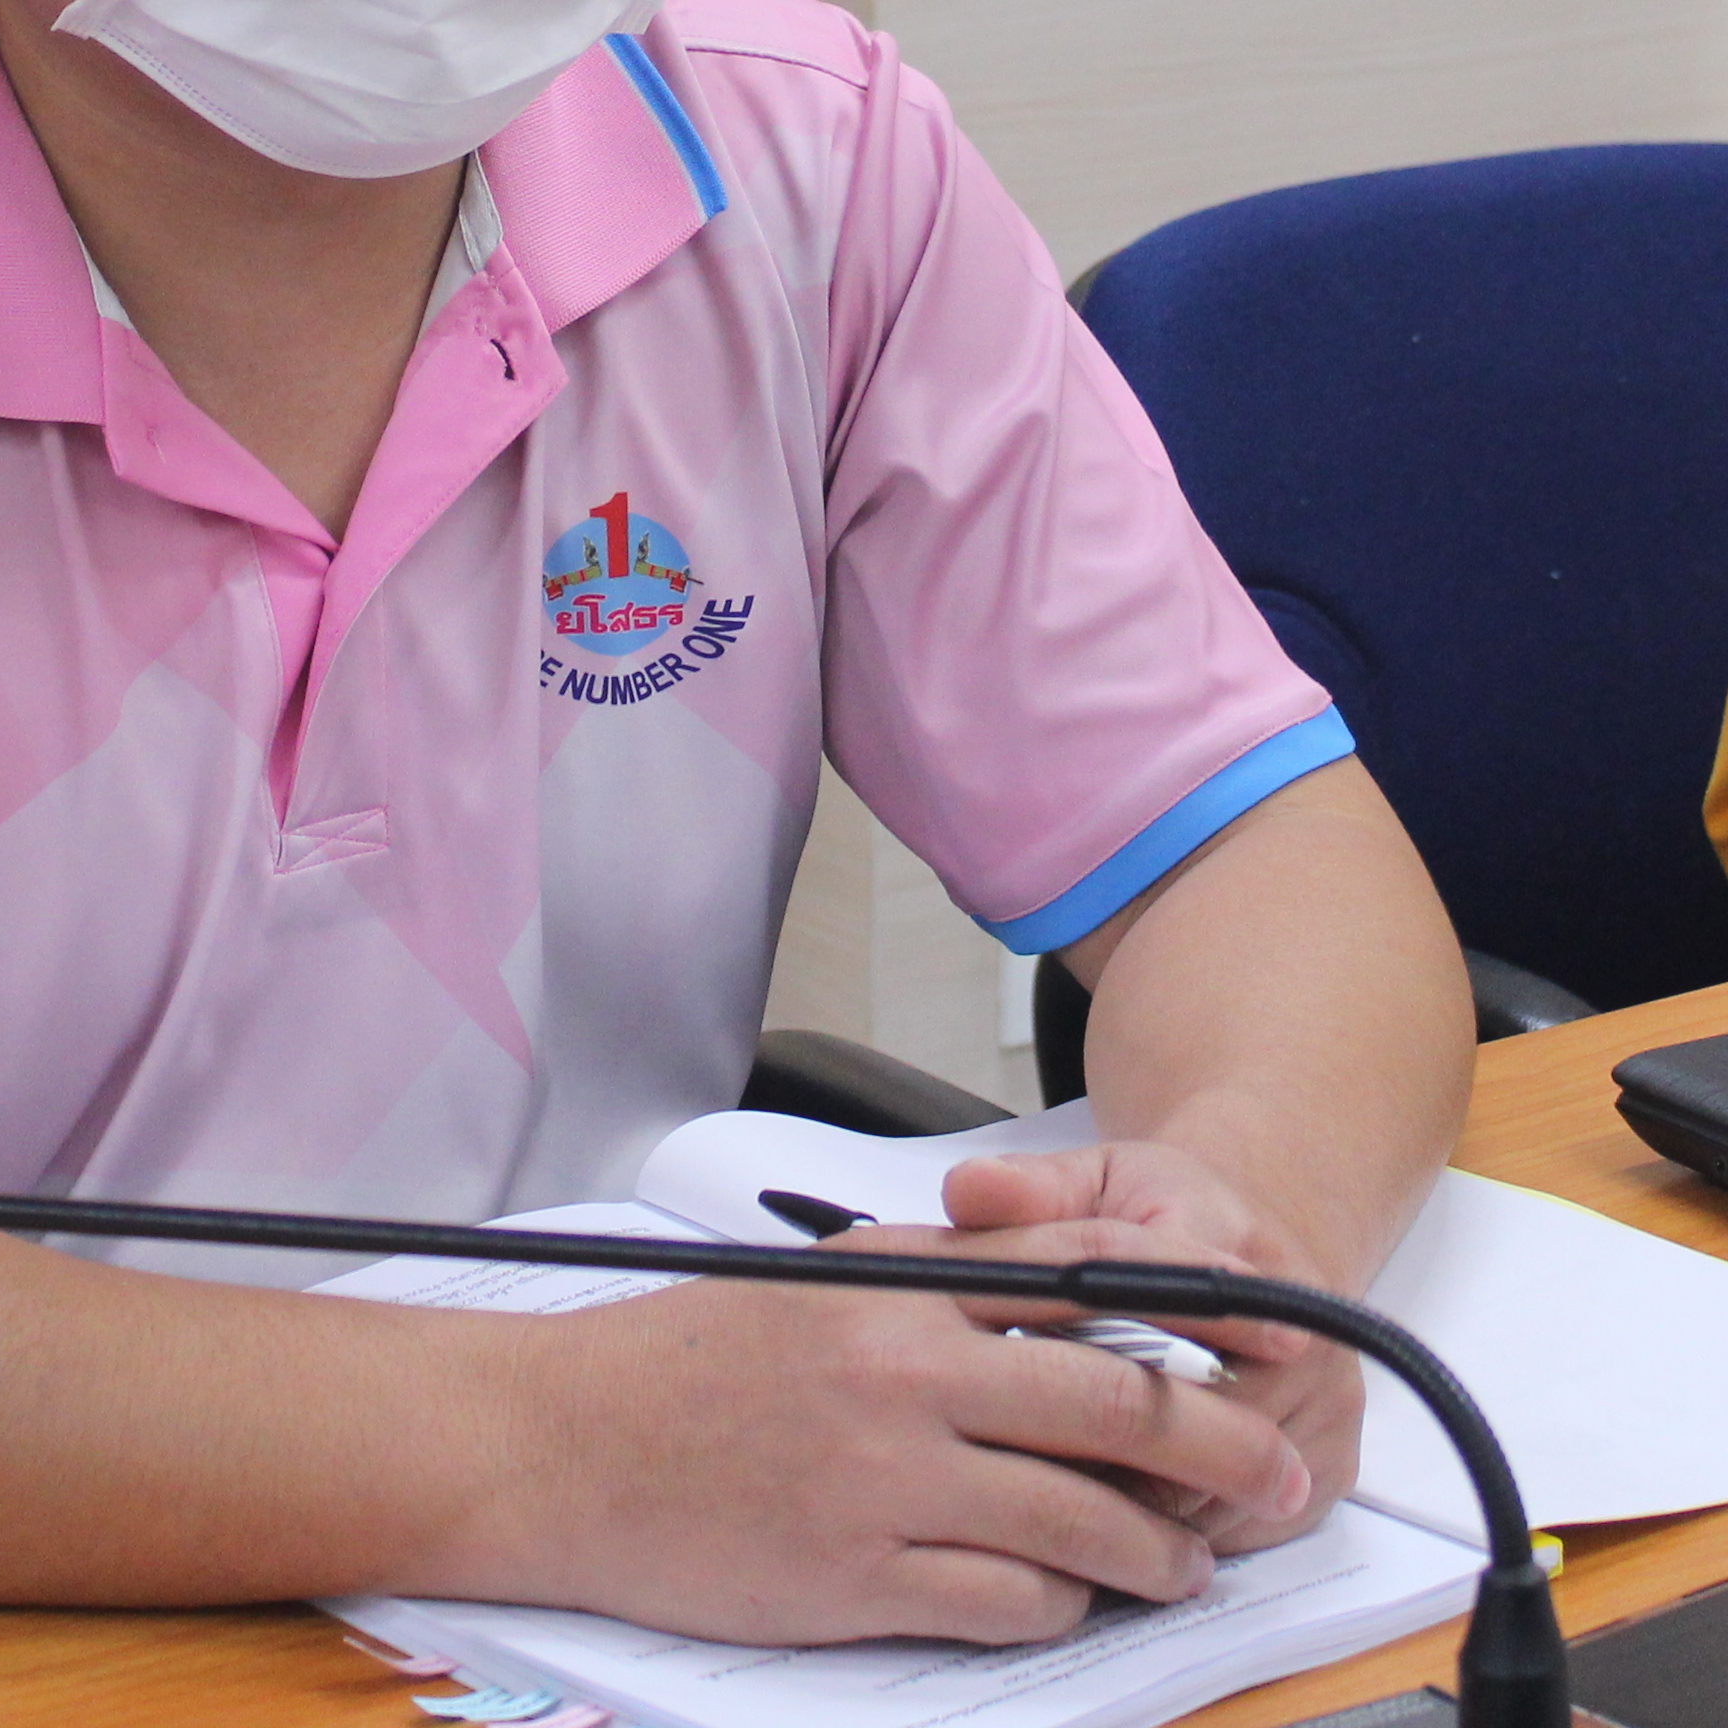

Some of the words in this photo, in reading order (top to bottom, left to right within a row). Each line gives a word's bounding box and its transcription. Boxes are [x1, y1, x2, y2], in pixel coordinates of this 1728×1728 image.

[589, 491, 630, 579] 1
[555, 593, 685, 635] ยโสธร
[558, 652, 701, 706] NUMBER
[681, 594, 755, 660] ONE
